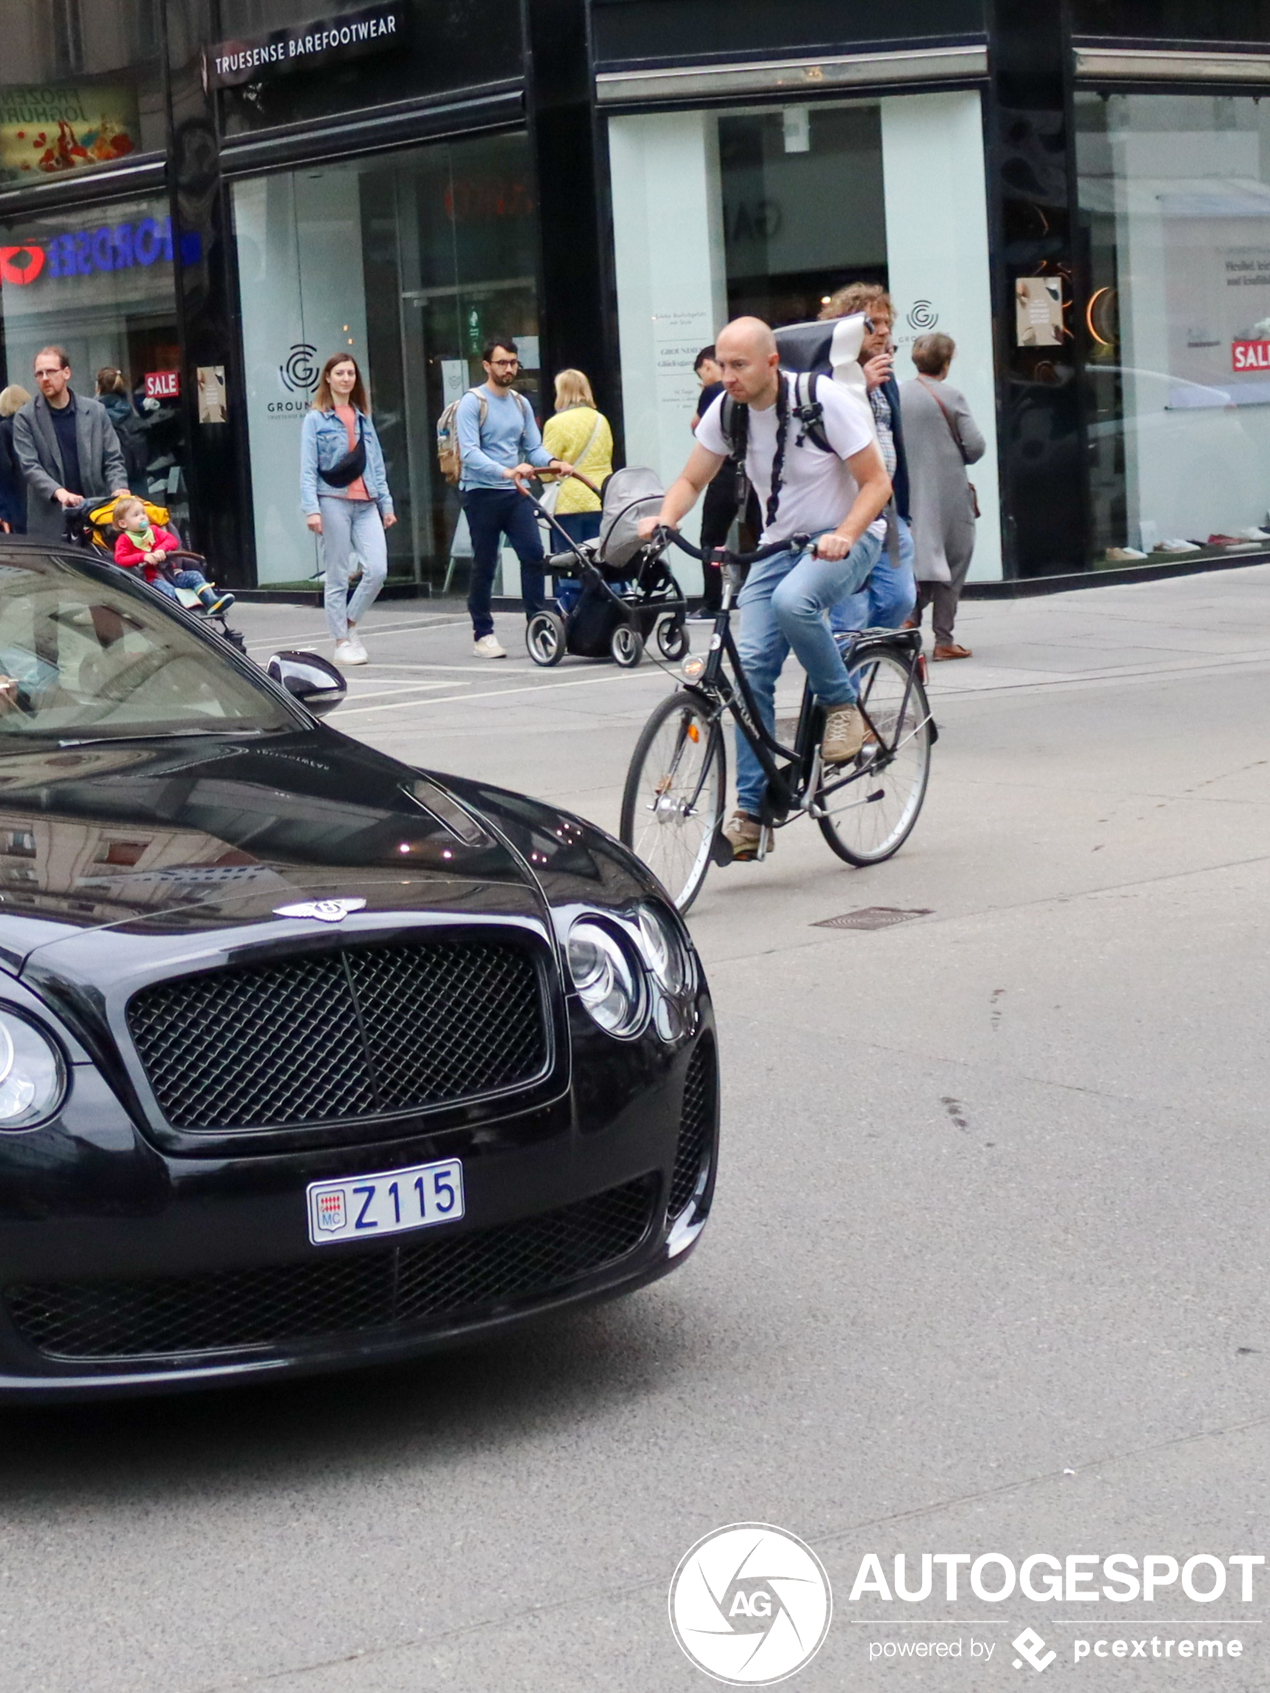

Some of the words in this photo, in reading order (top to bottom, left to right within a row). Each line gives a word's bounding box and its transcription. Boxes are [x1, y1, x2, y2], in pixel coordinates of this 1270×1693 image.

[215, 43, 285, 75] TRUESENSE
[289, 15, 397, 58] BAREFOOTWEAR
[147, 373, 177, 396] SALE
[322, 1212, 341, 1226] MC
[352, 1170, 455, 1230] Z115
